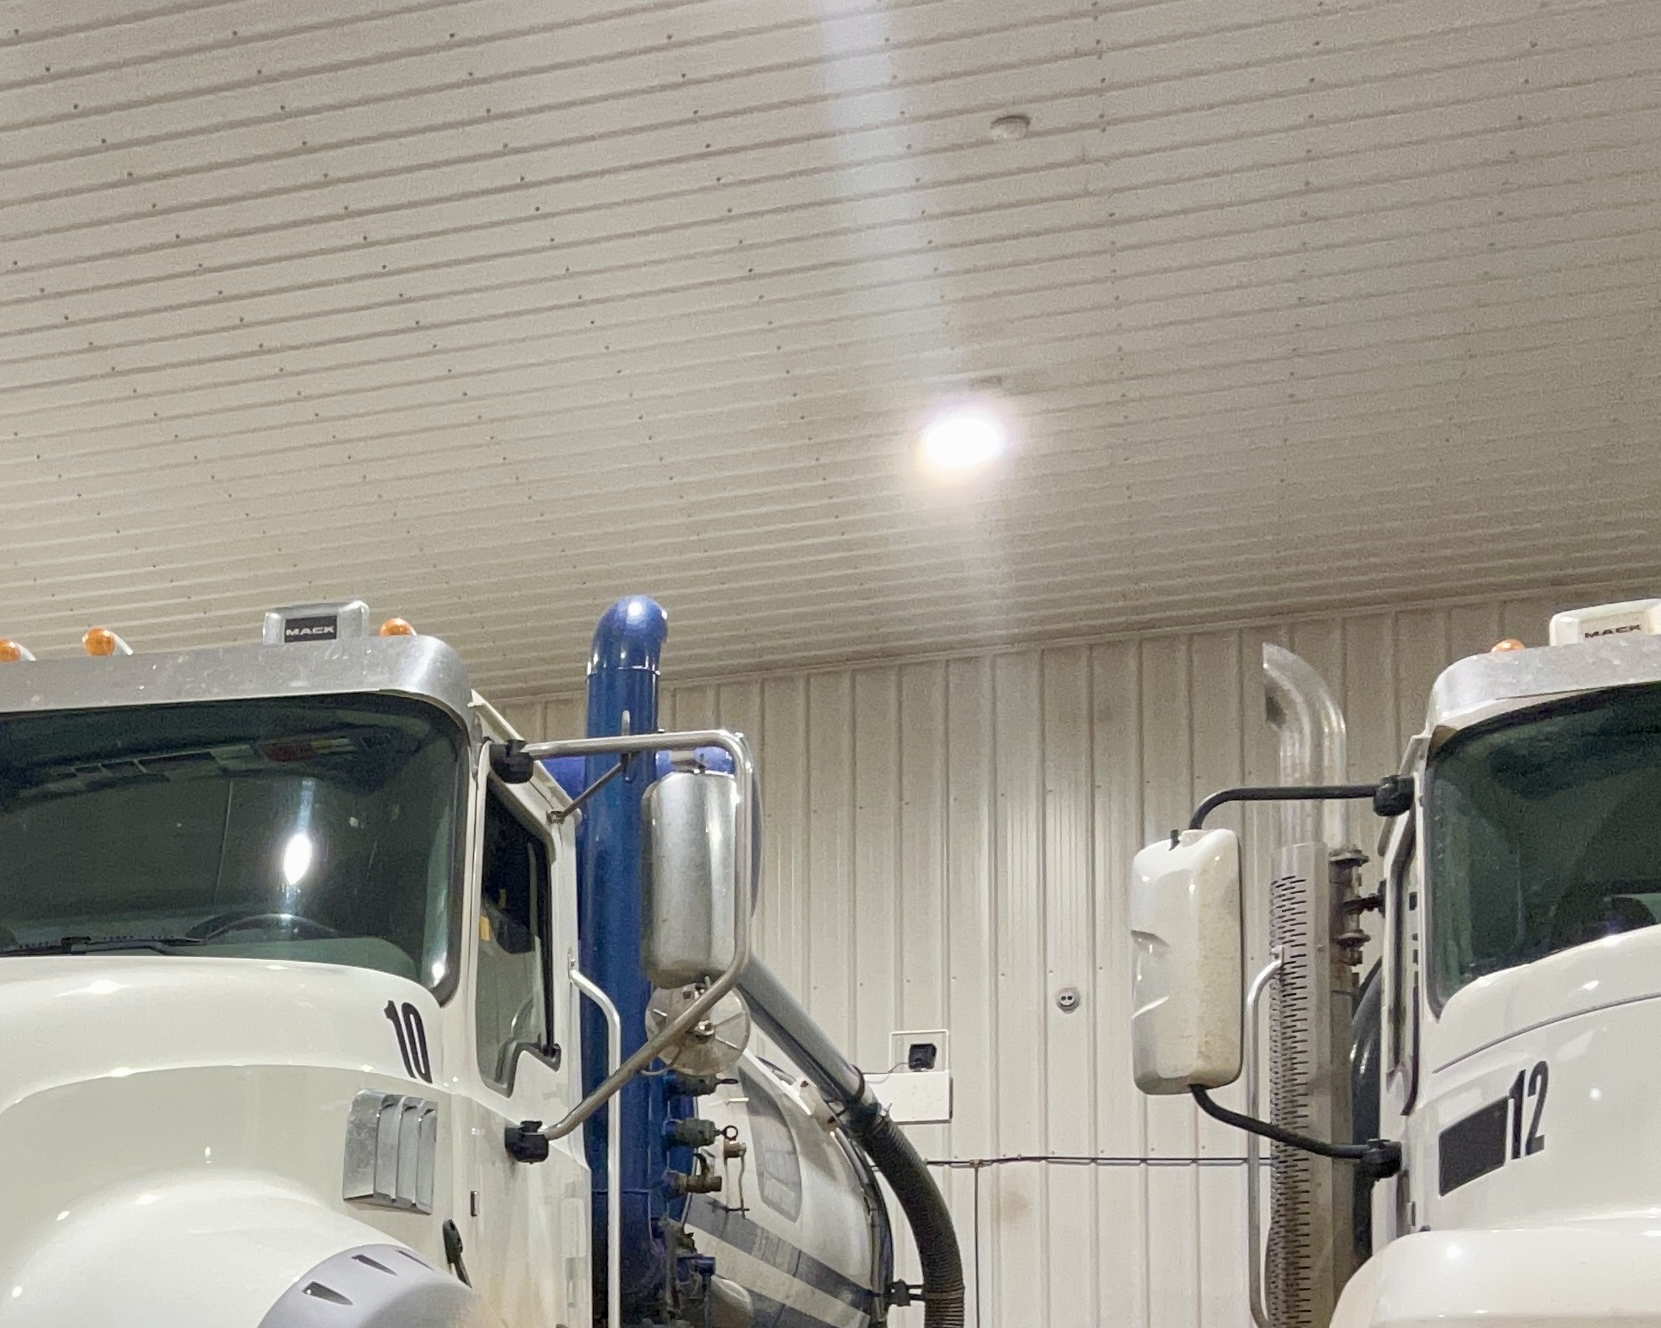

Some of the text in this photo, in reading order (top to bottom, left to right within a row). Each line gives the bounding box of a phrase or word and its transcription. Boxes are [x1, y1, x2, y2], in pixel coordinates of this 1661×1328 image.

[286, 625, 335, 637] MACK
[1584, 624, 1641, 638] MACK
[383, 999, 433, 1084] 10
[1508, 1060, 1549, 1161] 12
